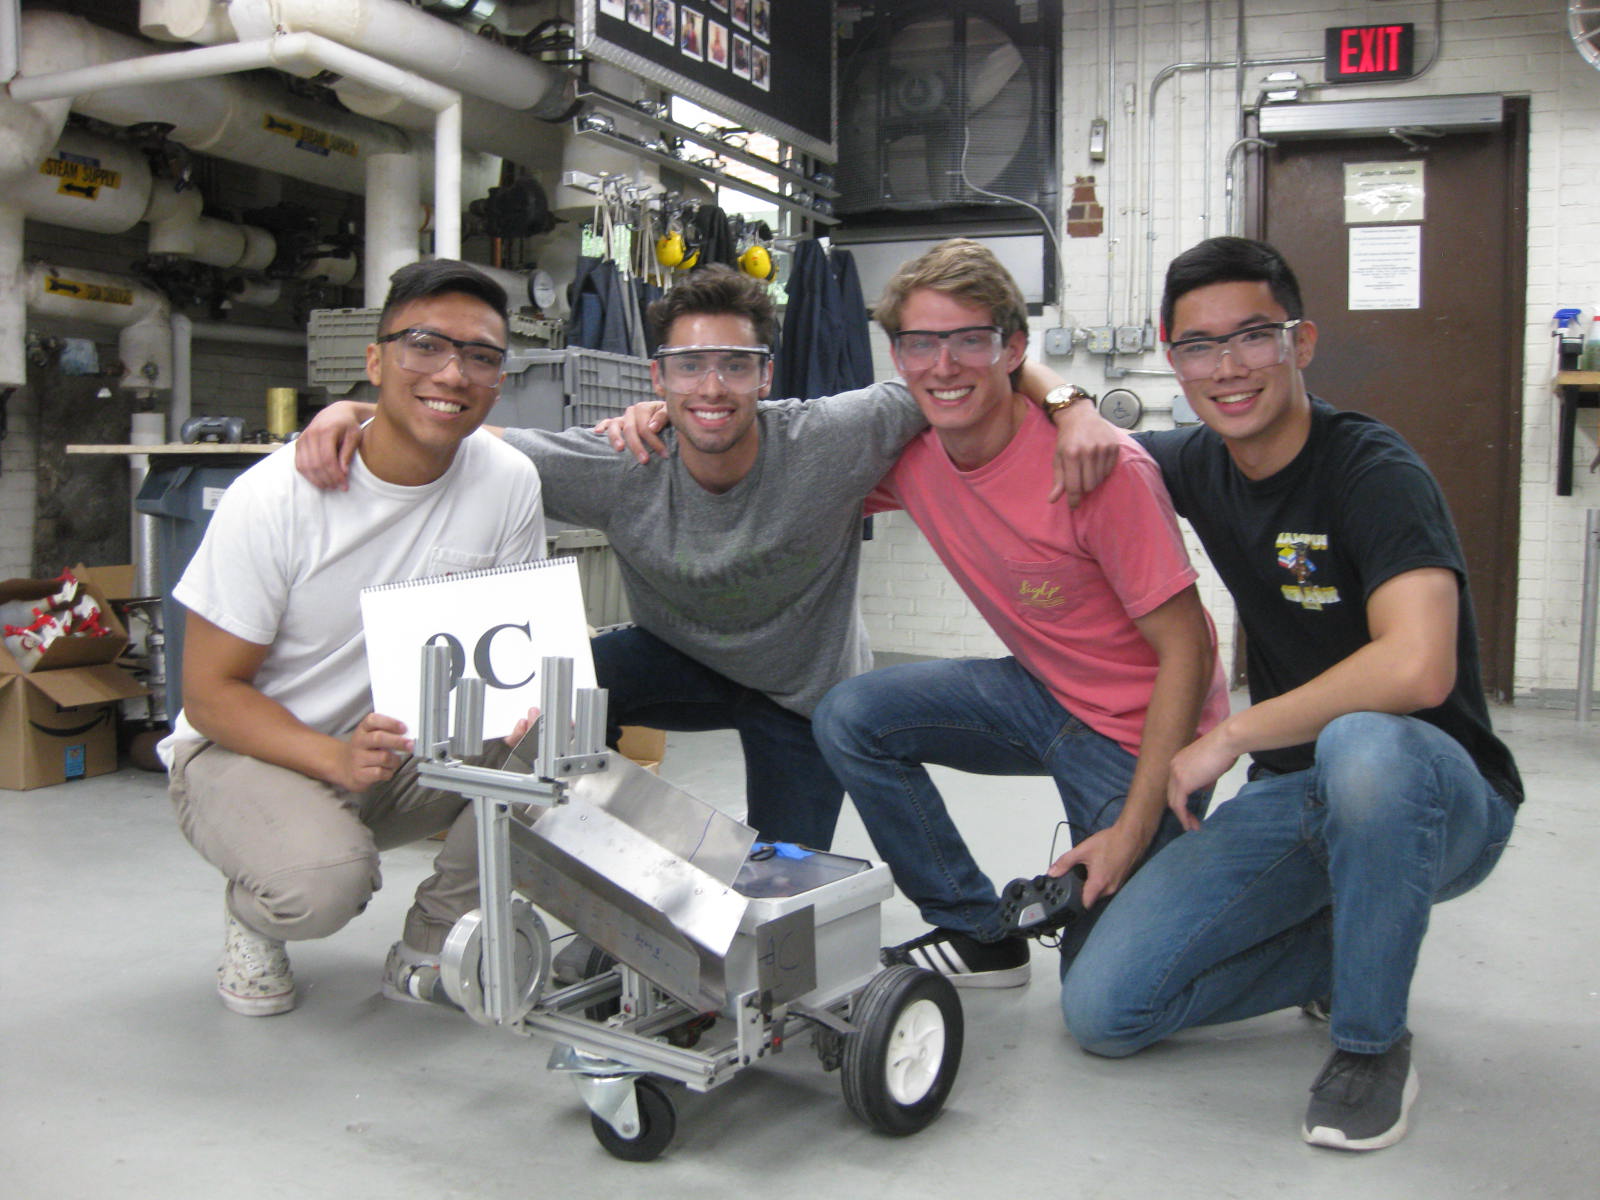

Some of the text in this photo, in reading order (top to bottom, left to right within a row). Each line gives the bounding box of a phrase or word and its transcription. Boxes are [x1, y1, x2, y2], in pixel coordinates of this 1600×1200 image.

[1340, 26, 1403, 74] EXIT
[45, 157, 79, 178] STEAM
[81, 166, 119, 188] SUPPLY
